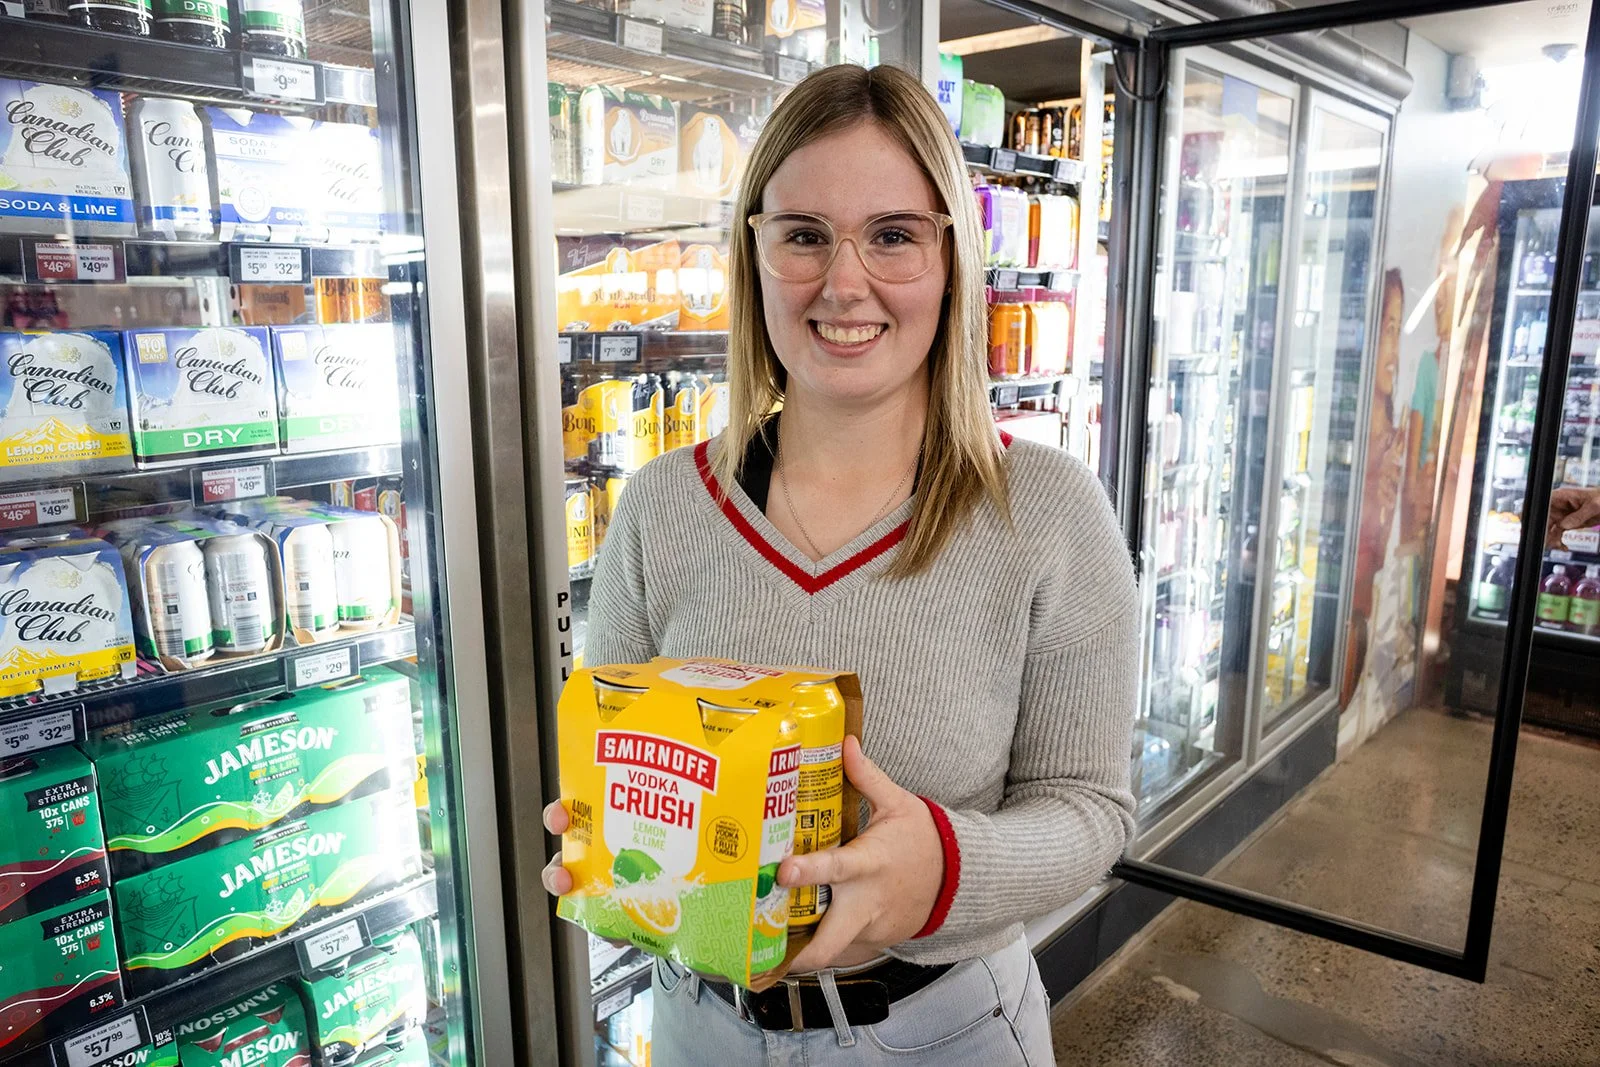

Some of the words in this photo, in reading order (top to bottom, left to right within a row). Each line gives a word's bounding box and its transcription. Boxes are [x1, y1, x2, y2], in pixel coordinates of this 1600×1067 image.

[184, 0, 219, 14] DRY
[6, 100, 116, 156] Canadian
[21, 127, 92, 167] Club
[0, 199, 55, 212] SODA
[58, 203, 70, 213] &
[73, 204, 118, 215] LIME
[141, 337, 161, 354] 10
[143, 353, 164, 361] CANS
[175, 347, 263, 385] Canadian
[8, 353, 113, 394] Canadian
[23, 378, 90, 409] Club
[187, 370, 242, 399] Club
[183, 427, 244, 448] DRY
[6, 444, 55, 458] LEMON
[58, 440, 101, 453] CRUSH
[0, 588, 116, 622] Canadian
[15, 614, 91, 642] Club
[557, 591, 571, 682] PULL
[2, 661, 81, 680] REFRESHMENT
[39, 724, 71, 740] $3299
[148, 720, 187, 734] CANS
[204, 727, 335, 785] JAMESON
[604, 737, 709, 780] SMIRNOFF
[45, 782, 80, 797] EXTRA
[627, 769, 679, 795] VODKA
[38, 786, 88, 806] STRENGTH
[610, 782, 695, 830] CRUSH
[38, 807, 59, 820] 10x
[61, 795, 91, 814] CANS
[45, 816, 64, 829] 375
[633, 820, 667, 839] LEMON
[632, 834, 641, 844] &
[643, 835, 666, 851] LIME
[714, 838, 738, 852] FRUIT
[219, 832, 344, 898] JAMESON
[75, 870, 100, 886] 6.3%
[53, 911, 103, 933] STRENGTH
[61, 908, 94, 924] EXTRA
[54, 934, 75, 947] 10x
[77, 921, 105, 939] CANS
[61, 942, 79, 956] 375
[89, 992, 114, 1008] 6.3%
[179, 985, 279, 1036] JAMESON
[69, 1034, 93, 1048] JAMESON
[84, 1031, 123, 1058] $5799
[155, 1029, 172, 1041] 10%
